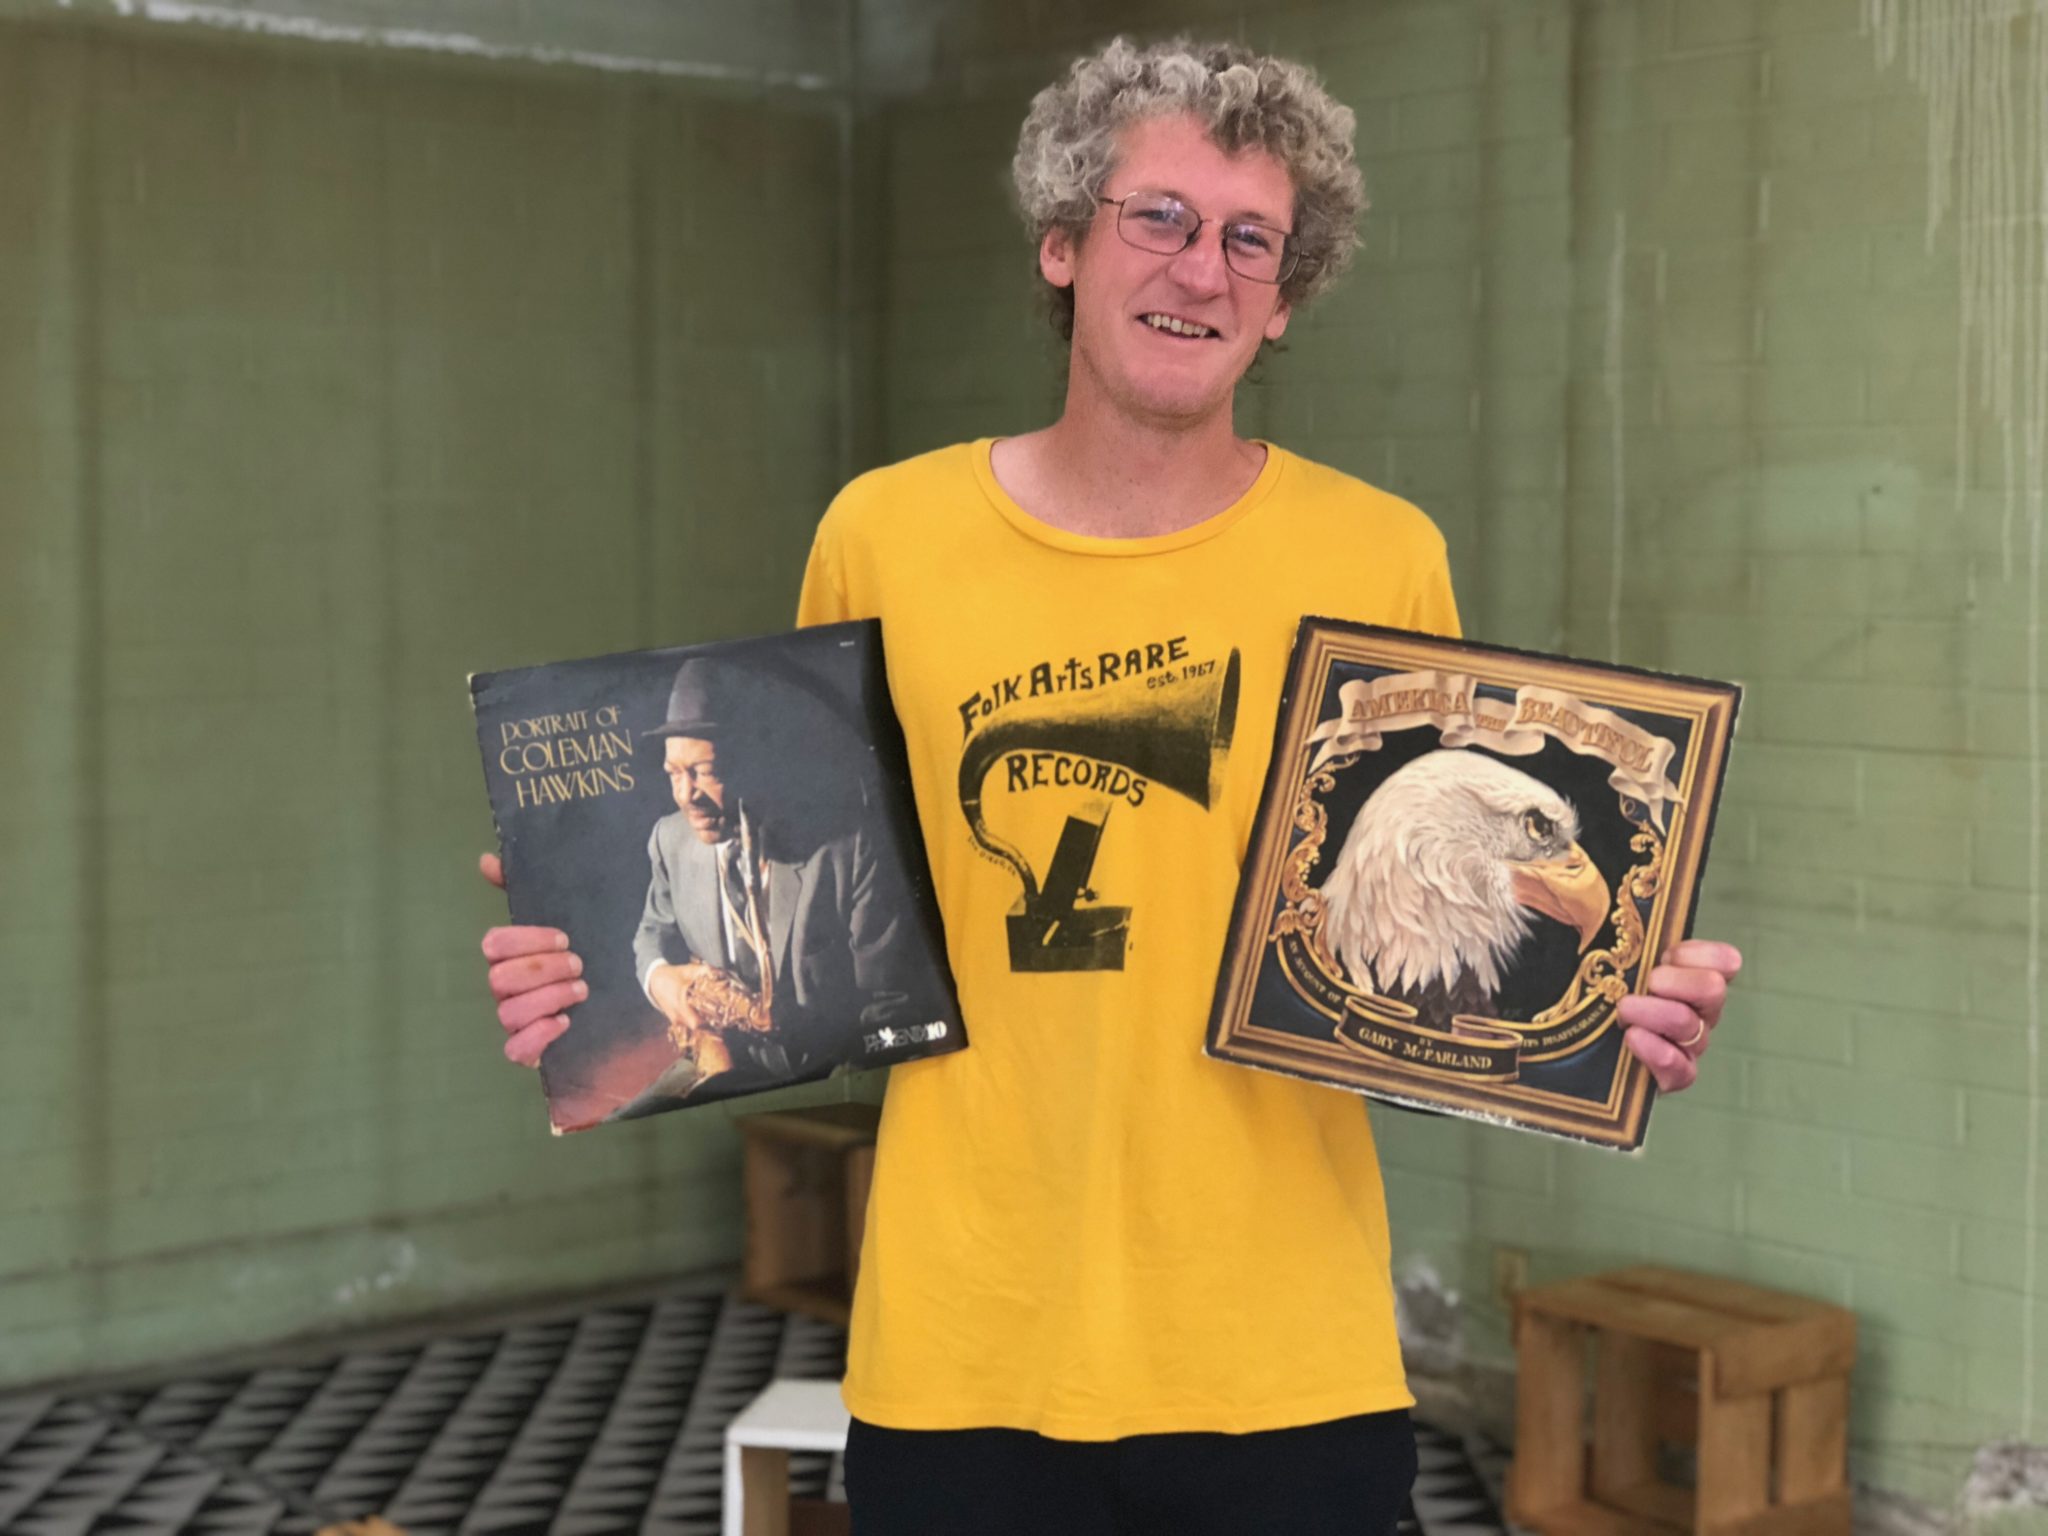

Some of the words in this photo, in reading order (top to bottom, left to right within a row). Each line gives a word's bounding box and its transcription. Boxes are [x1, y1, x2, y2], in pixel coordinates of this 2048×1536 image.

[1098, 636, 1189, 686] RARE
[501, 710, 588, 746] PORTRAIT
[596, 705, 621, 727] OF
[1349, 689, 1472, 722] AMERICA
[1516, 697, 1654, 773] BEAUTIFUL
[500, 729, 633, 775] COLEMAN
[515, 762, 635, 808] HAWKINS
[1006, 753, 1148, 807] RECORDS
[1358, 1026, 1399, 1051] GARY
[1419, 1036, 1434, 1048] BY
